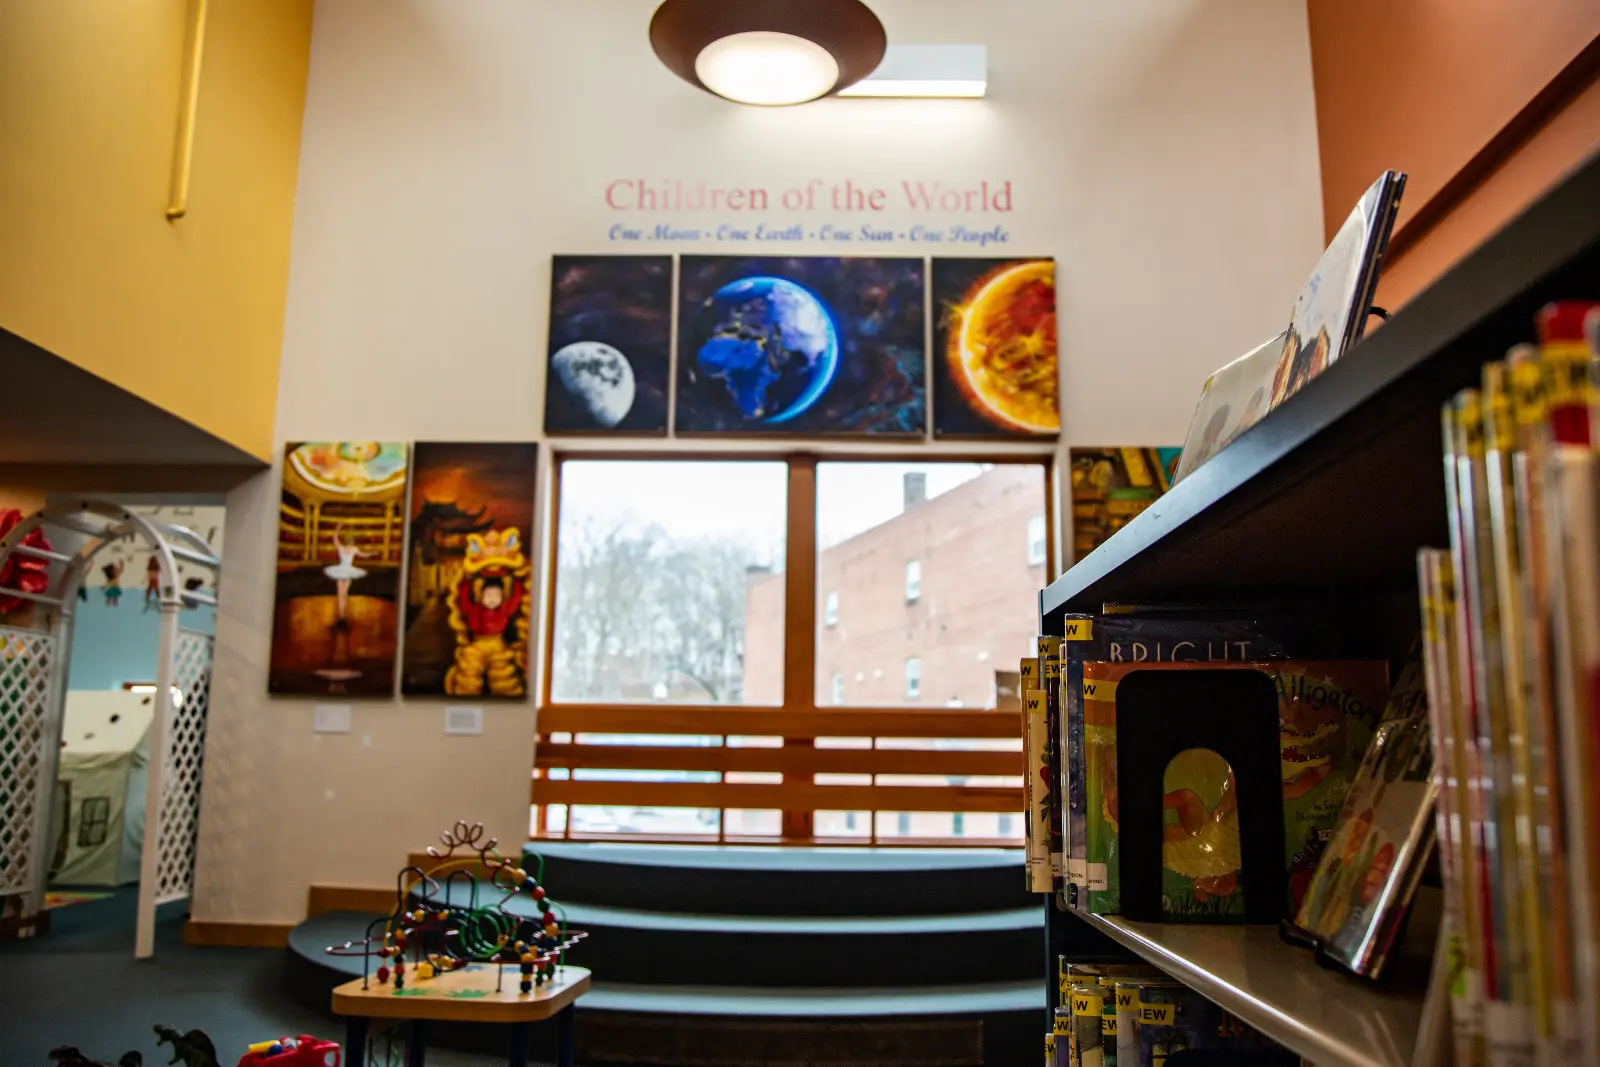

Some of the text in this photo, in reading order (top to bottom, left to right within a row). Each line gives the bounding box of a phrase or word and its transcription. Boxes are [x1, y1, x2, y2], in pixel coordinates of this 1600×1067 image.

[604, 178, 1013, 212] Children of the World
[609, 222, 1010, 247] One Moon One Earth One Sun One People
